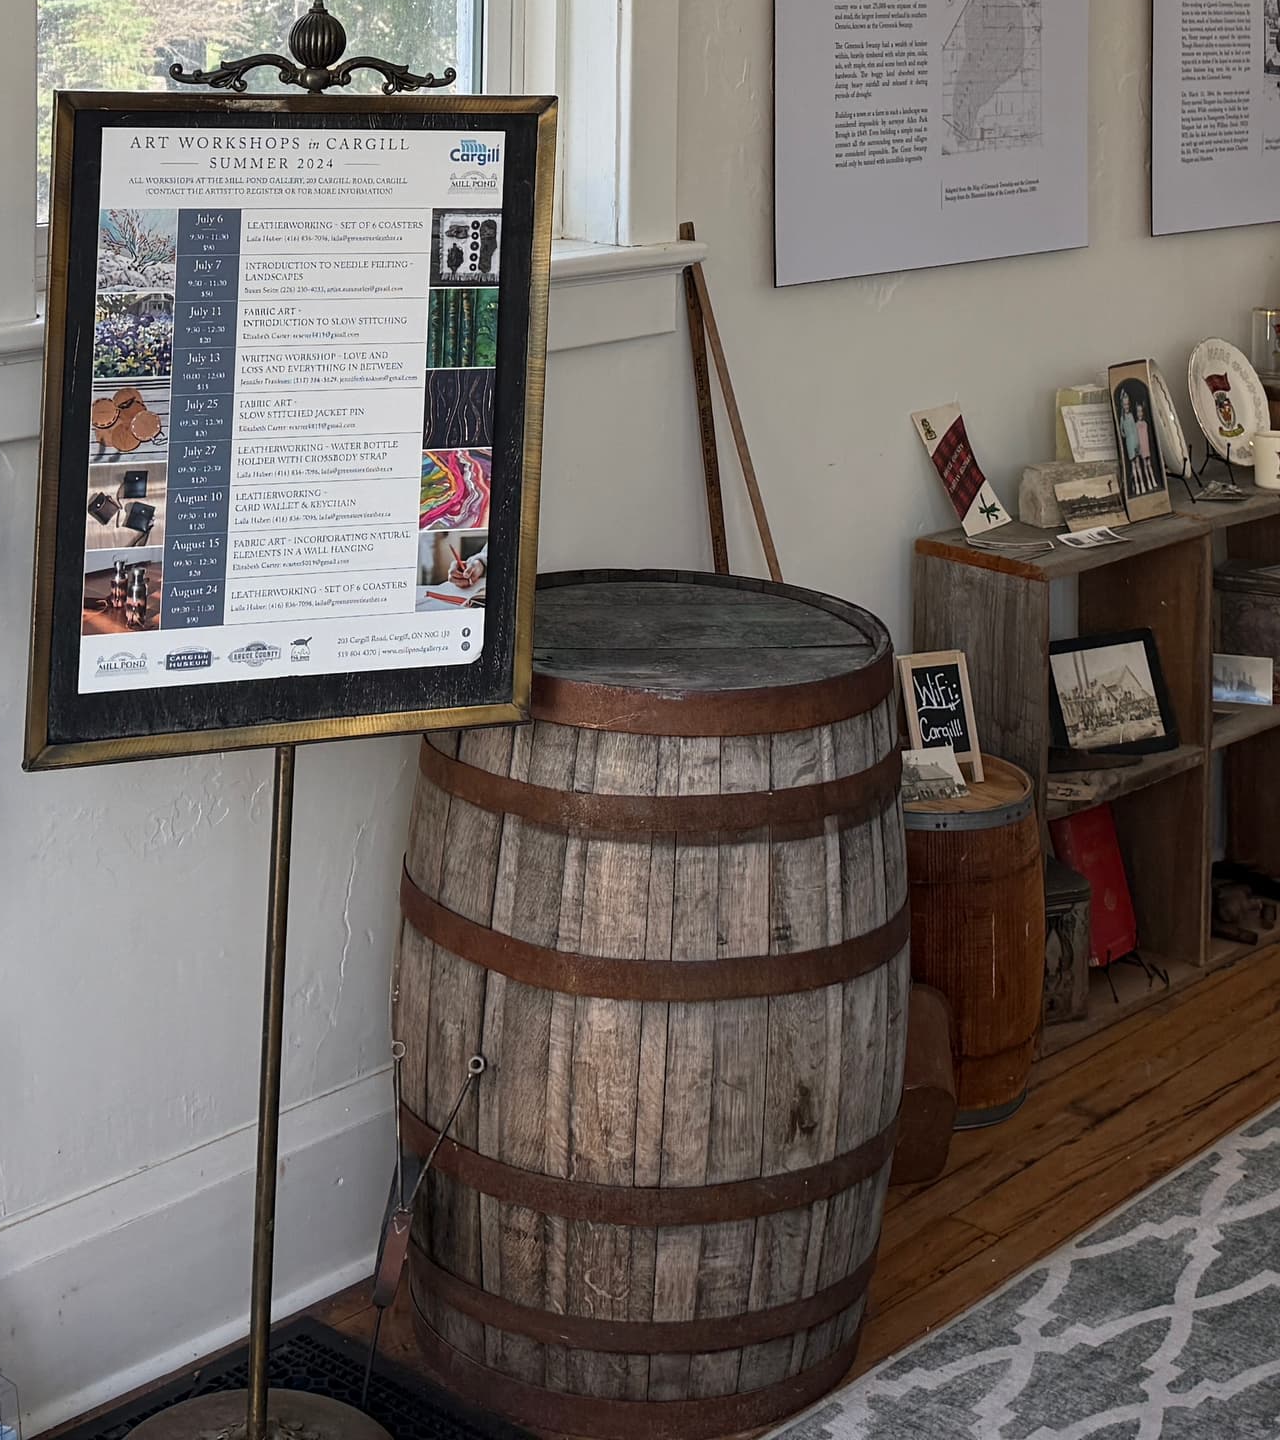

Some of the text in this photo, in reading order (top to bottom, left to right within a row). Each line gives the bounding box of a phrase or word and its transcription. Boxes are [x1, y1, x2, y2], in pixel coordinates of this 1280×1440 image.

[130, 136, 410, 150] ART WORKSHOPS in CARGILL
[450, 144, 500, 165] Cargill
[209, 157, 333, 169] SUMMER 2024
[196, 214, 223, 225] July 6
[194, 260, 221, 272] July 7
[245, 260, 408, 271] INTRODUCTION TO NEEDLE FELTING
[245, 272, 303, 282] LANDSCAPES
[189, 306, 221, 319] July 11
[174, 492, 222, 504] August 10
[913, 673, 959, 708] WiFi:
